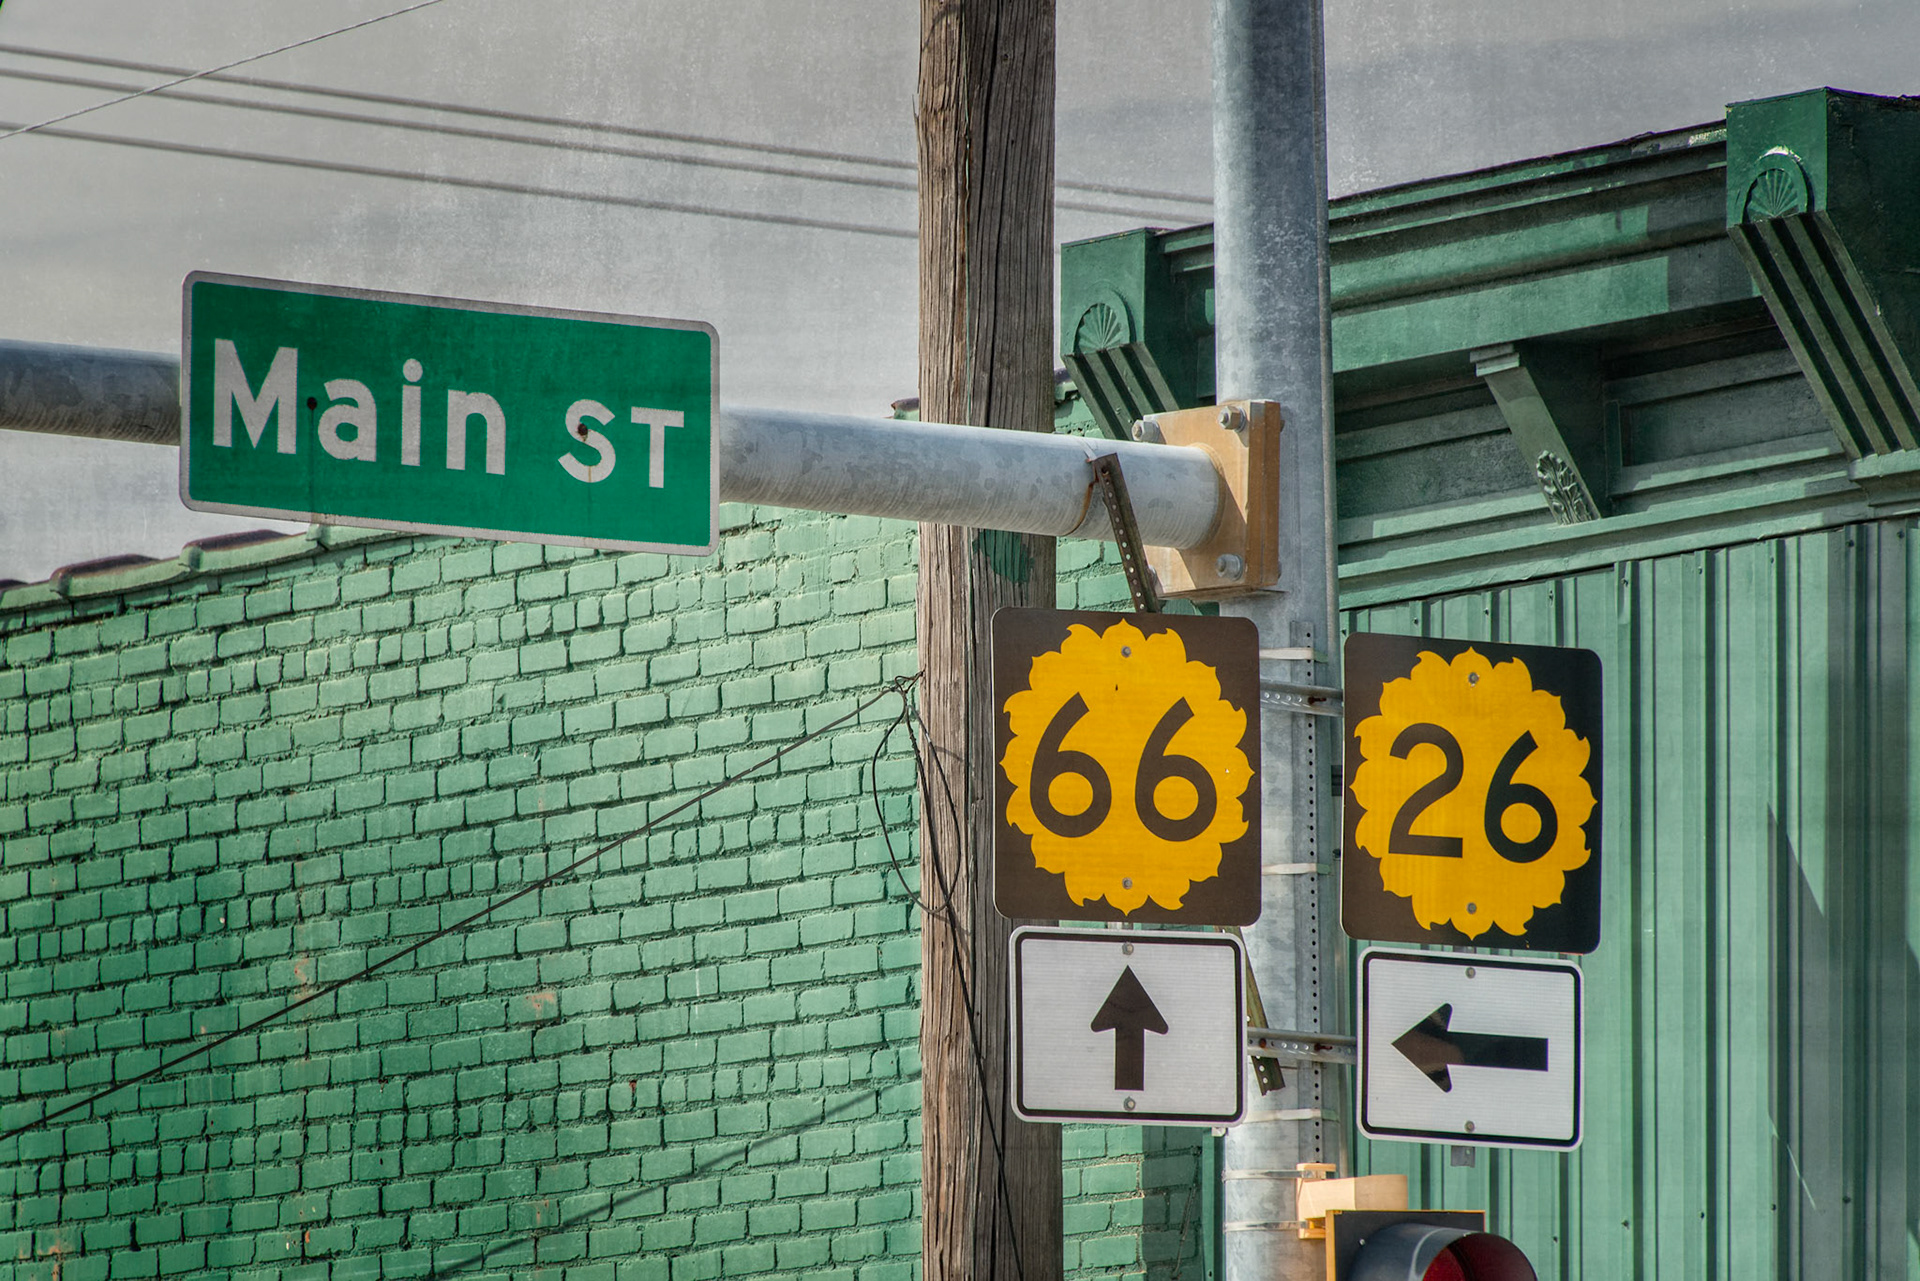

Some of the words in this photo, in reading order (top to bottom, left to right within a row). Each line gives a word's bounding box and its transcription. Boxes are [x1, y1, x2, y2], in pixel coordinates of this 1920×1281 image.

[212, 338, 506, 476] Main
[557, 398, 685, 489] ST
[1029, 692, 1218, 842] 66
[1387, 722, 1559, 864] 26
